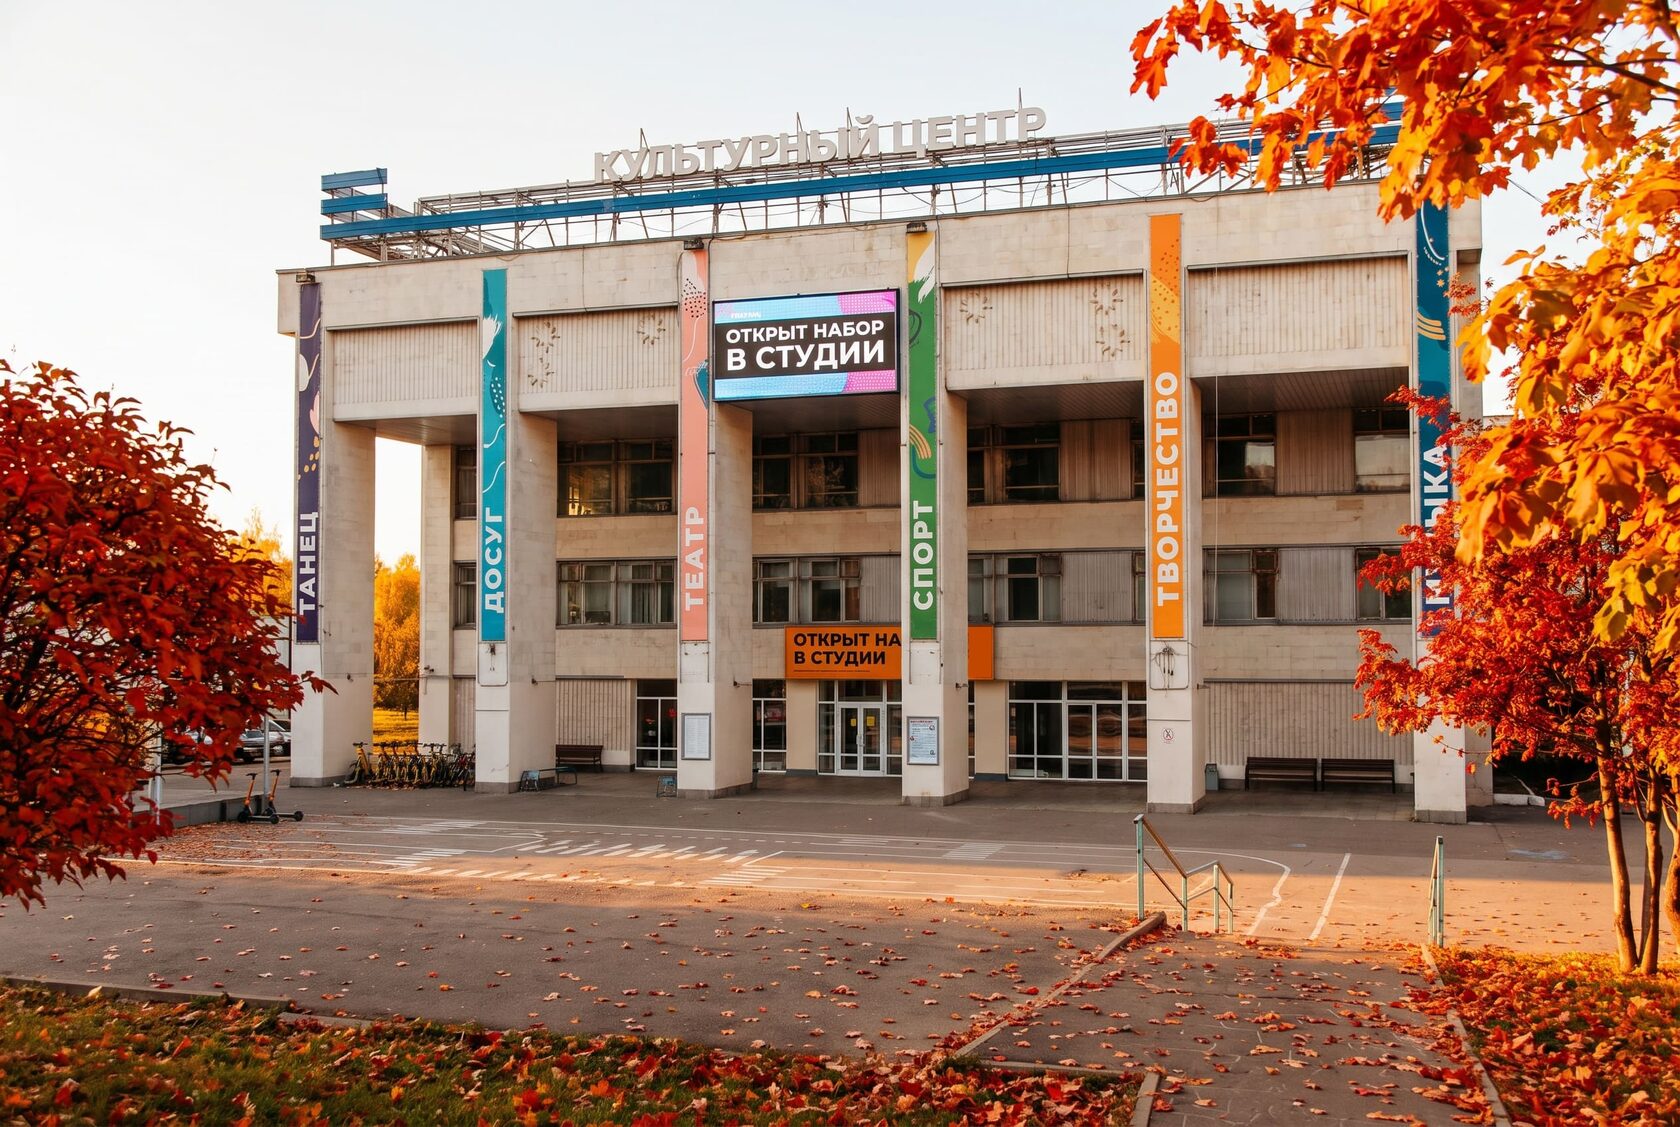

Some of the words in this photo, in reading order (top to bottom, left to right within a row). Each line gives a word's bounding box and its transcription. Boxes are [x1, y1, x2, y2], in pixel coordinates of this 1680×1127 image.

[594, 114, 880, 184] КУЛЬТУРНЫЙ
[892, 106, 1047, 158] ЦЕНТР
[725, 324, 808, 344] ОТКРЫТ
[813, 319, 884, 339] НАБОР
[727, 348, 747, 371] В
[755, 340, 884, 371] СТУДИИ
[1155, 371, 1180, 607] ТВОРЧЕСТВО
[299, 511, 318, 616] ТАНЕЦ
[485, 507, 504, 613] ДОСУГ
[685, 506, 704, 611] ТЕАТР
[913, 500, 934, 610] СПОРТ
[793, 632, 870, 647] ОТКРЫТ
[794, 651, 806, 665] В
[811, 651, 886, 667] СТУДИИ
